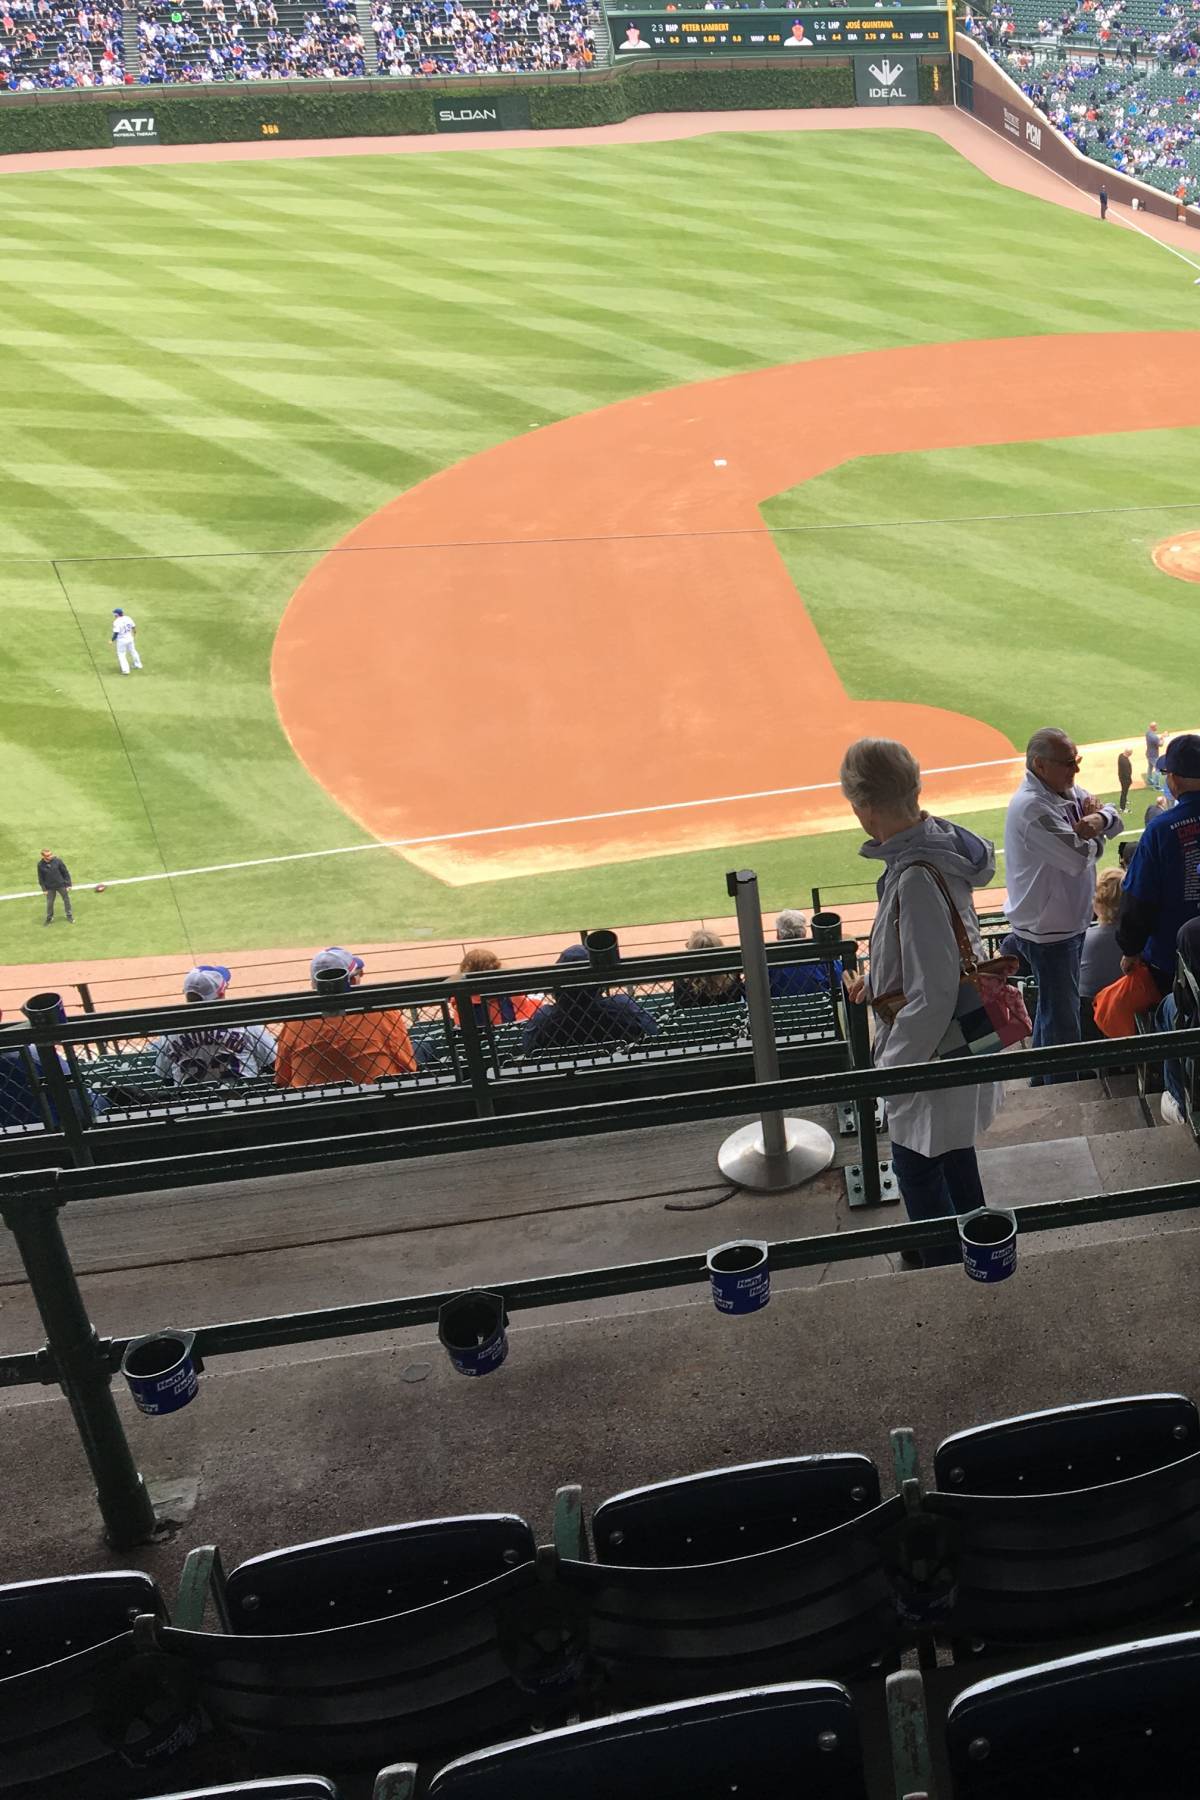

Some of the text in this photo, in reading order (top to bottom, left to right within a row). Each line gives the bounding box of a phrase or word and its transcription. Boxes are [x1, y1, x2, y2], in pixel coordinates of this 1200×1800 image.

[665, 24, 679, 32] RHP
[681, 23, 700, 32] PETER
[701, 23, 729, 31] LAMBERT
[828, 21, 840, 29] LHP
[861, 21, 894, 29] QUINTANA
[869, 87, 907, 98] IDEAL
[439, 109, 496, 121] SLOAN
[113, 118, 154, 132] ATI
[1170, 817, 1197, 830] NATIONAL
